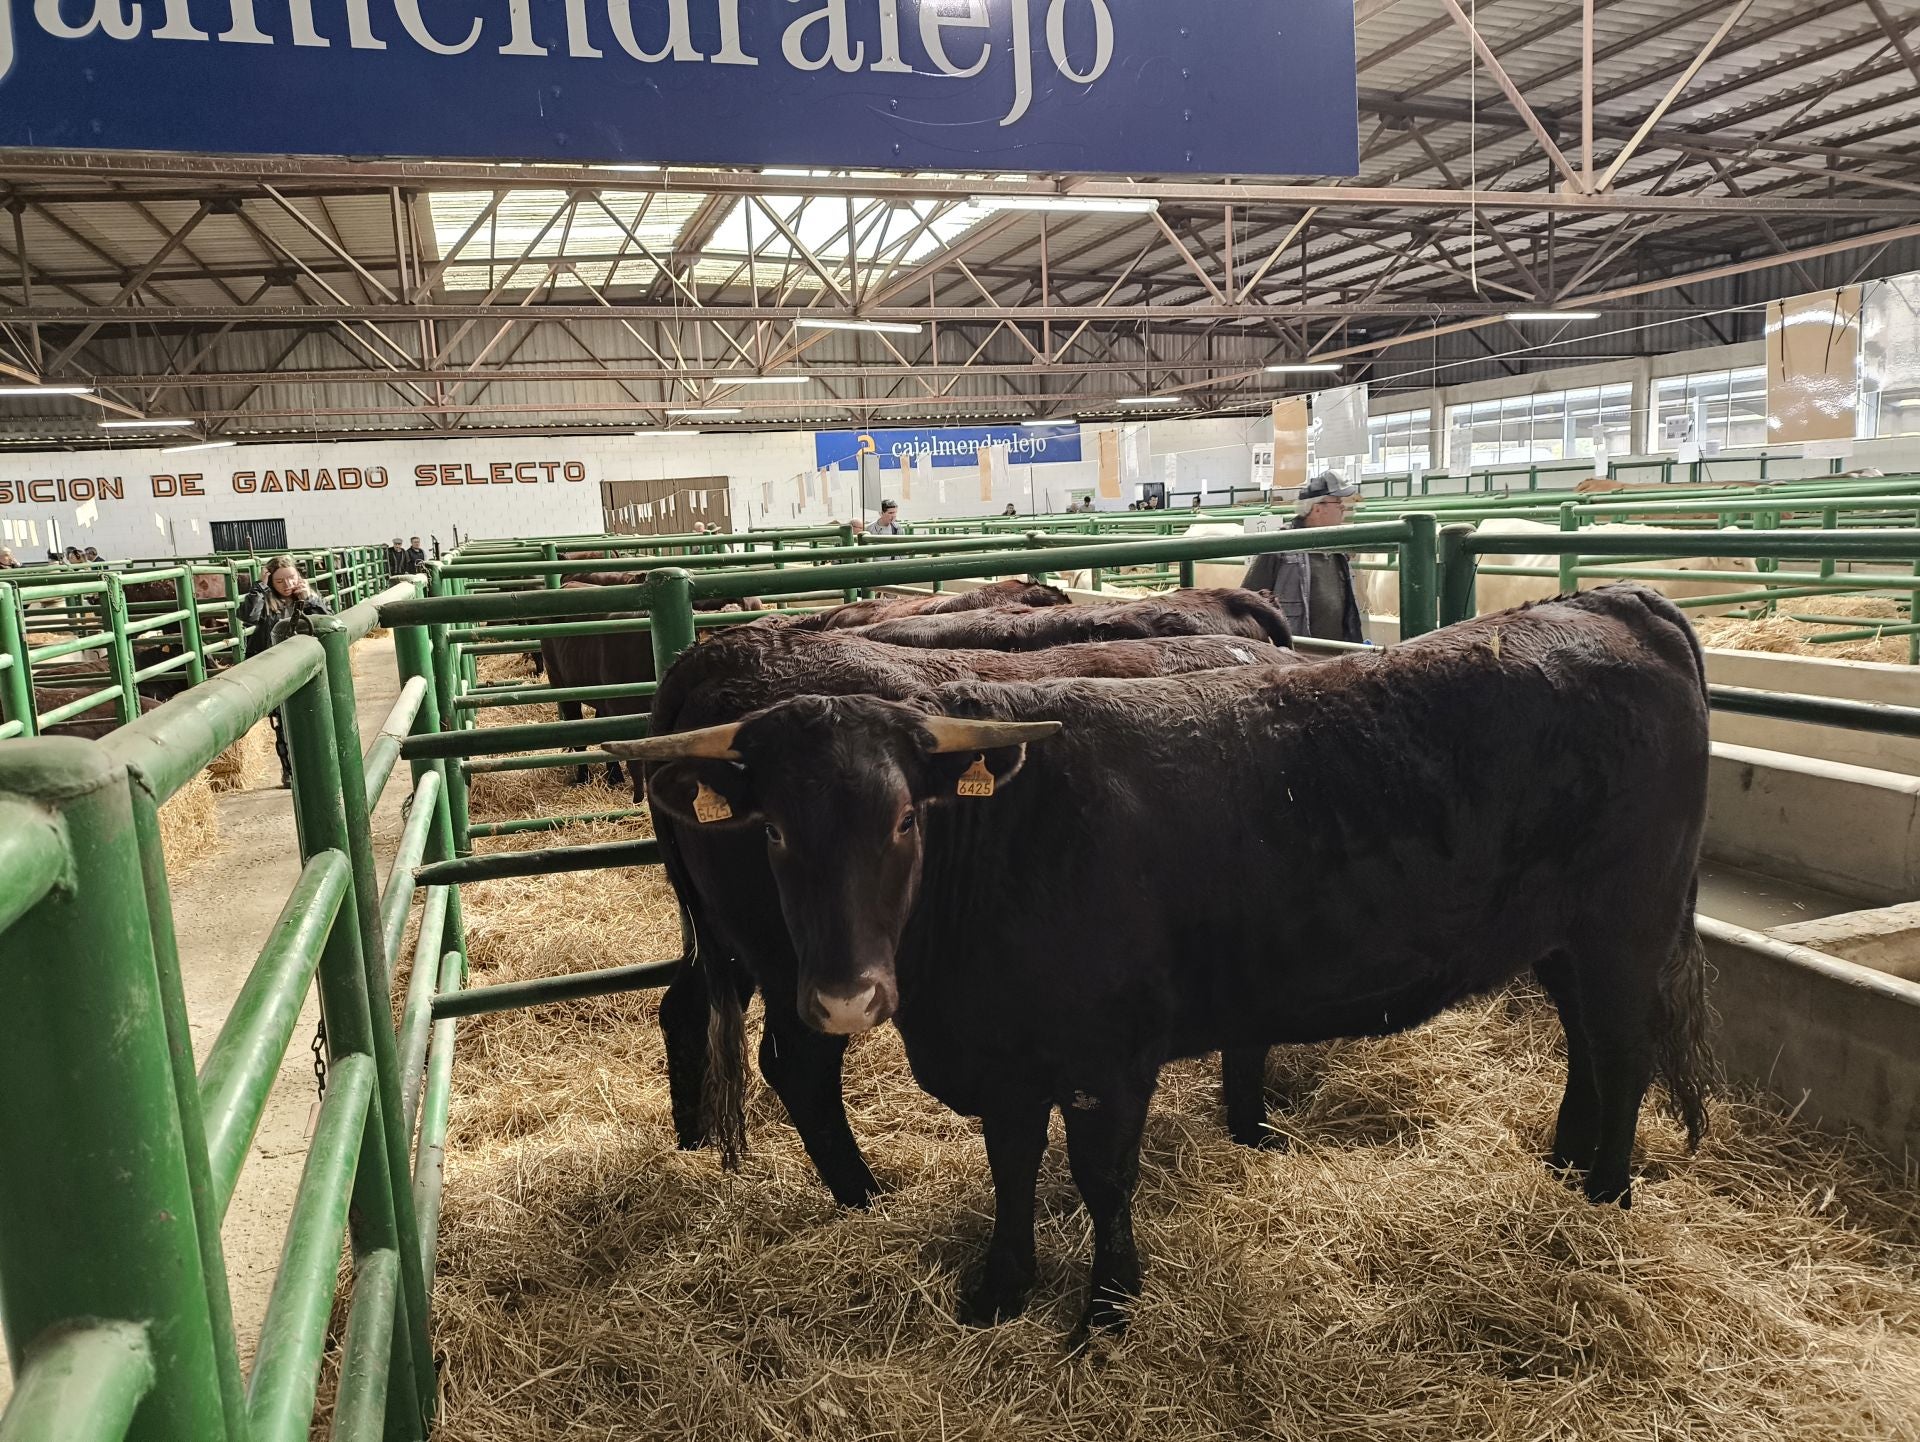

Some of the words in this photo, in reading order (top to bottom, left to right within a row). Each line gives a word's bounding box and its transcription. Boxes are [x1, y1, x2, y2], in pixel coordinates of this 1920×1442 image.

[151, 473, 205, 498] DE
[232, 466, 389, 493] GANADO
[414, 461, 586, 486] SELECTO
[959, 782, 991, 795] 6425
